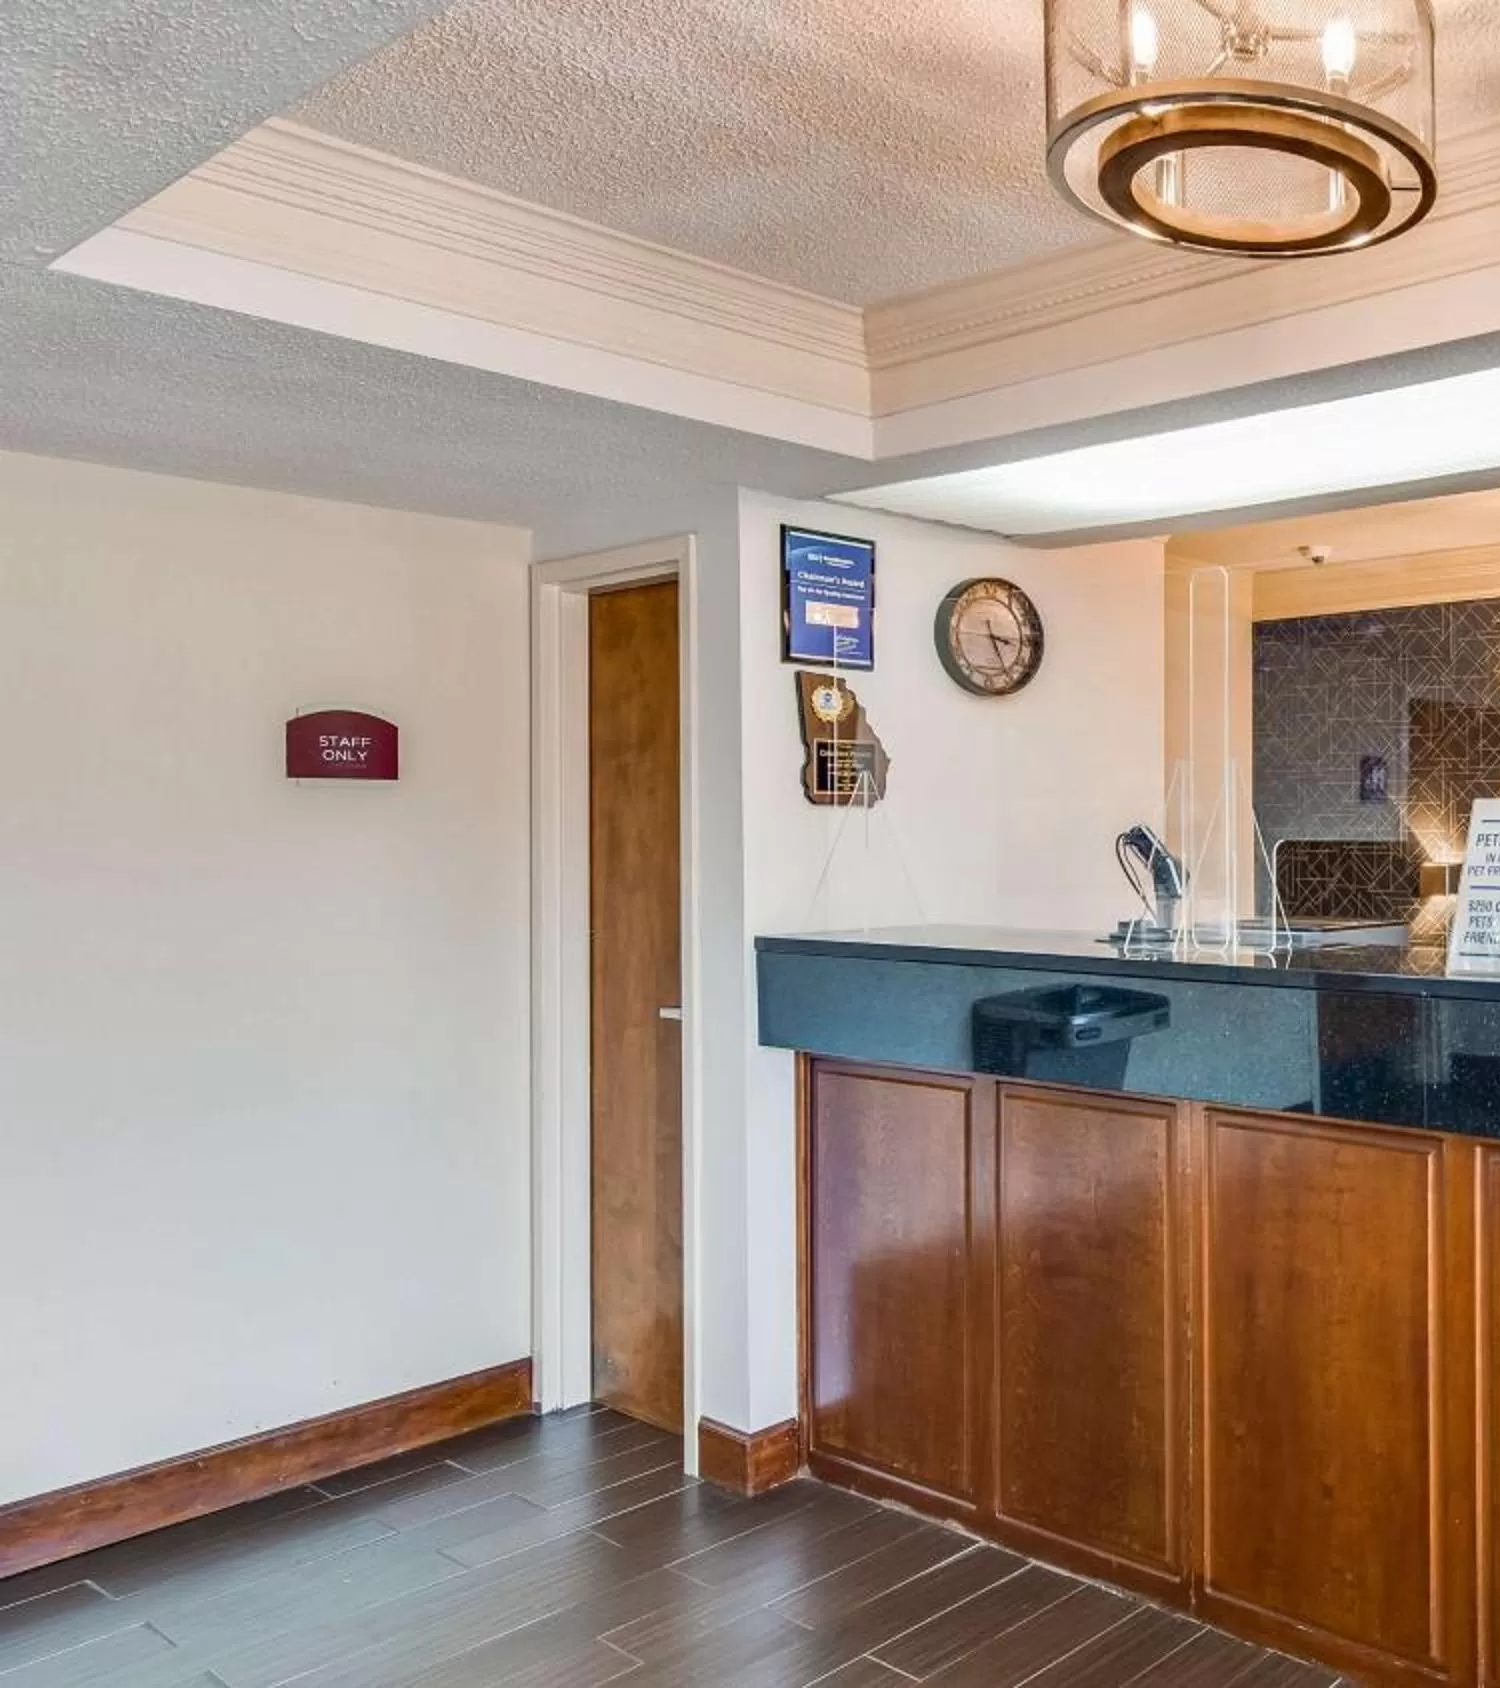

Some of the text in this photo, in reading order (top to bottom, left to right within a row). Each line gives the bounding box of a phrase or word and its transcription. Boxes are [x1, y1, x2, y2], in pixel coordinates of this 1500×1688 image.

[319, 735, 373, 748] STAFF
[322, 748, 368, 761] ONLY
[1485, 852, 1497, 863] IN
[1467, 865, 1486, 877] PET
[1468, 914, 1493, 929] PETS
